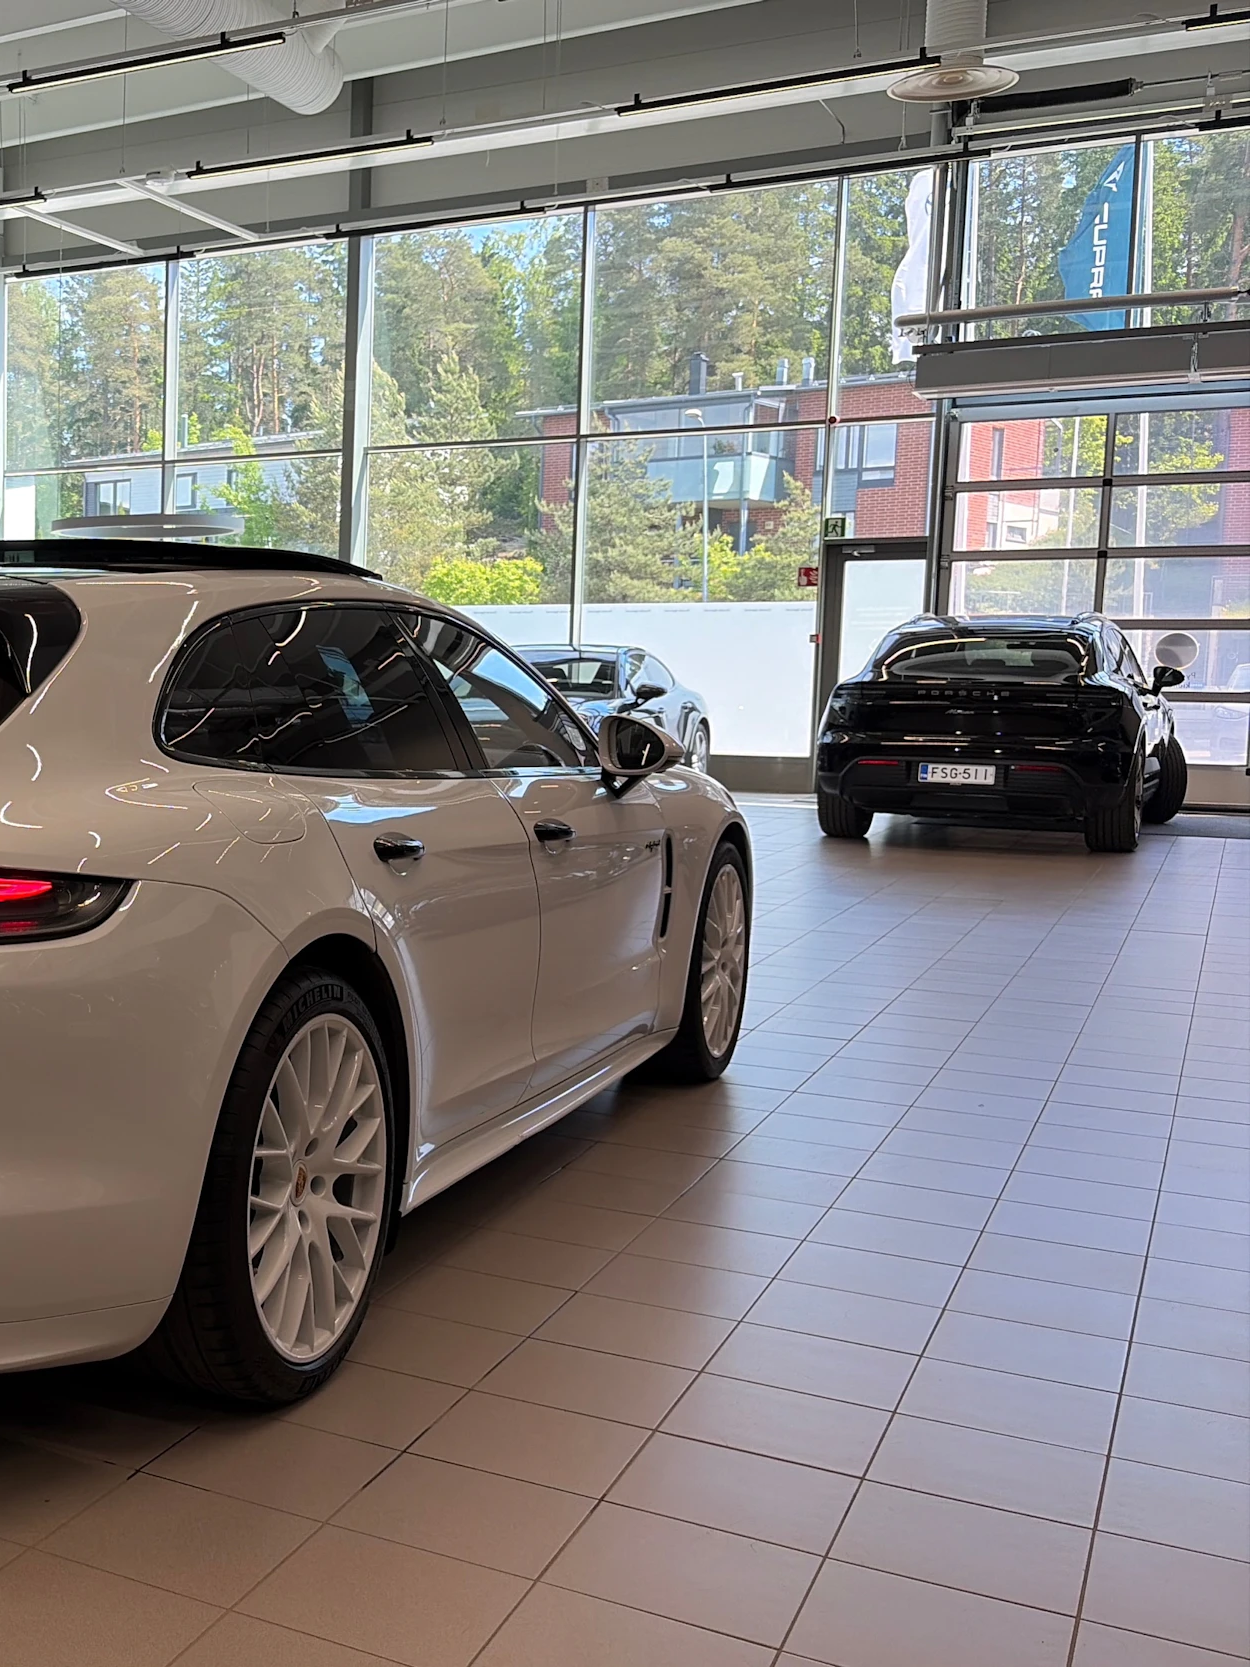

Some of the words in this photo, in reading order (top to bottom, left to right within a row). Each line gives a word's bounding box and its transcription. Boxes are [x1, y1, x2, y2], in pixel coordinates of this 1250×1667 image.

[917, 689, 1010, 697] PORSCHE
[931, 766, 988, 781] FSG-511
[282, 984, 344, 1034] MICHELIN
